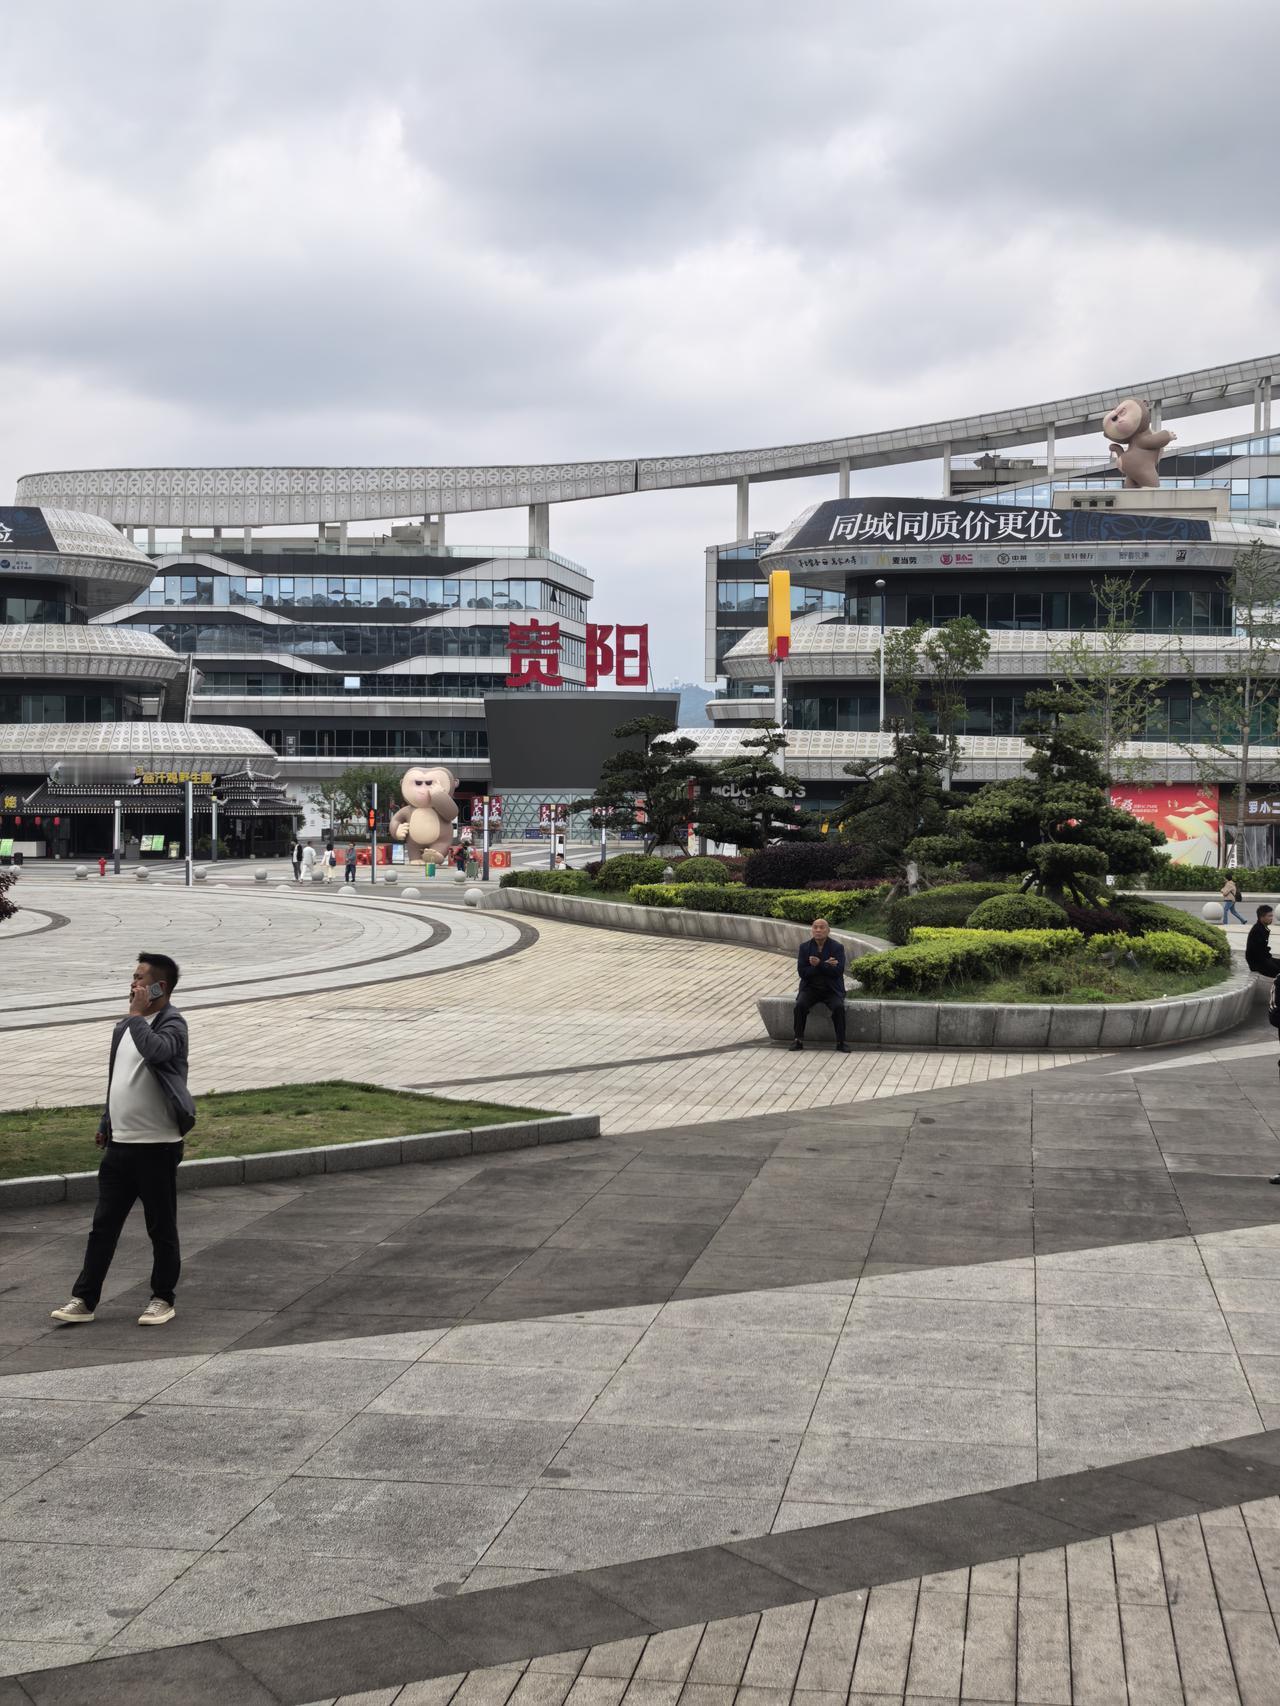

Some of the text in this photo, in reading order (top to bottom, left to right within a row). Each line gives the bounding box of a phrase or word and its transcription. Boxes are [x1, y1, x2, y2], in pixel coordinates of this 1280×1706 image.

[828, 510, 1063, 542] 同城同质价更优
[892, 556, 918, 565] 麦当劳
[505, 618, 648, 687] 贵阳
